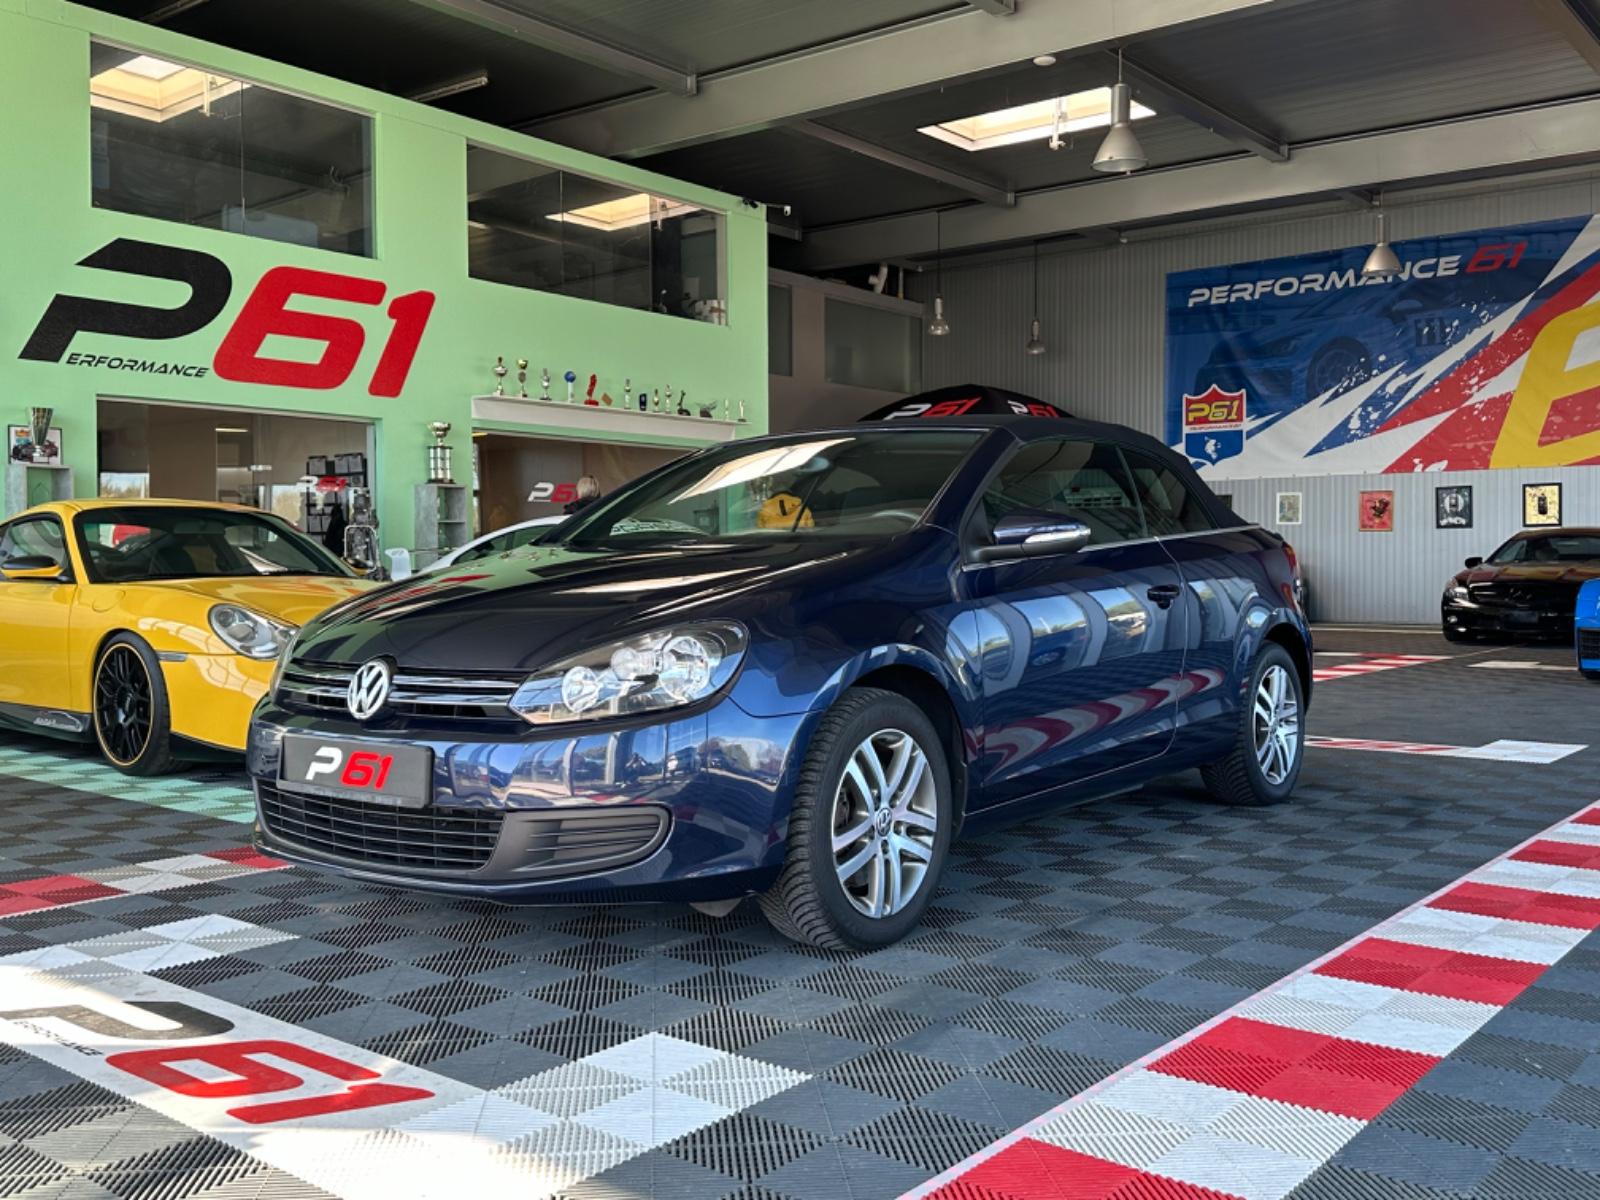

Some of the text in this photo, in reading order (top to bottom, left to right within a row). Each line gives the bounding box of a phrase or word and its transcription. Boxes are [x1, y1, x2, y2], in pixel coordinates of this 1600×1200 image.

[1465, 240, 1529, 273] 61
[18, 237, 436, 398] P61
[65, 352, 210, 378] ERFORMANCE
[1187, 400, 1240, 422] P61
[528, 482, 579, 503] P6
[304, 746, 393, 791] P61
